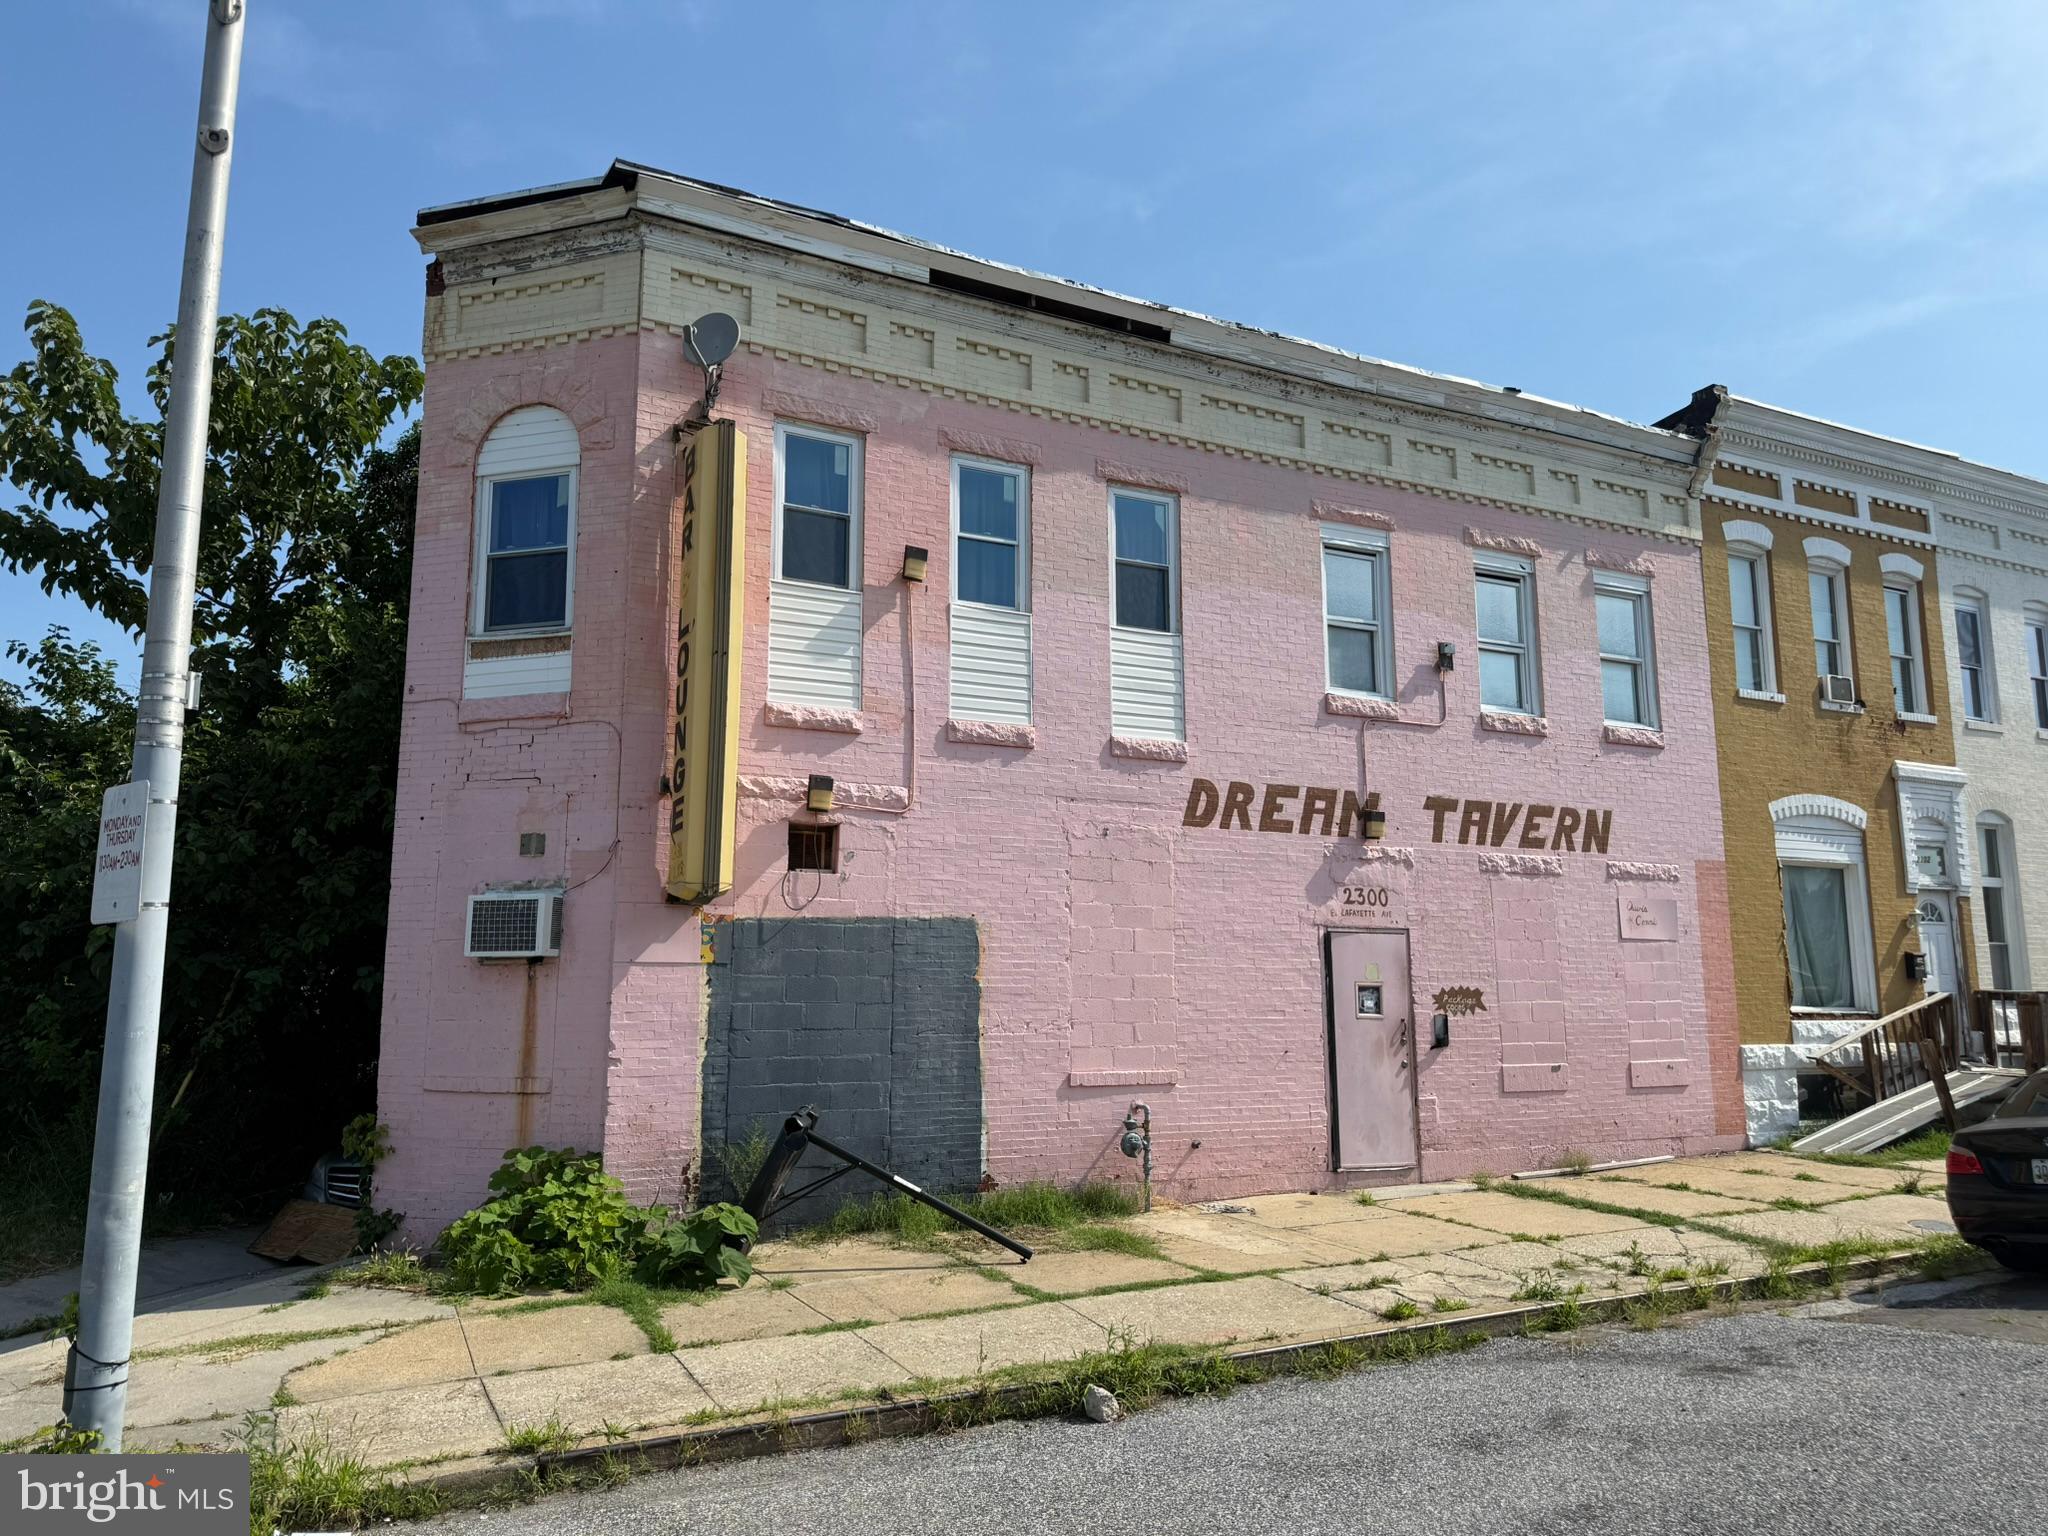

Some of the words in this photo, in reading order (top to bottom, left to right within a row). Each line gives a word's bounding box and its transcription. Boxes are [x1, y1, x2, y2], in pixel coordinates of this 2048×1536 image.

[682, 444, 696, 560] BAR
[671, 608, 695, 834] LOUNGE
[103, 815, 130, 833] MONDAY
[129, 815, 142, 828] AND
[1422, 795, 1613, 854] TAVERN
[106, 828, 137, 847] THURSDAY
[1343, 887, 1388, 907] 2300
[1341, 909, 1376, 918] LAFAYETTE
